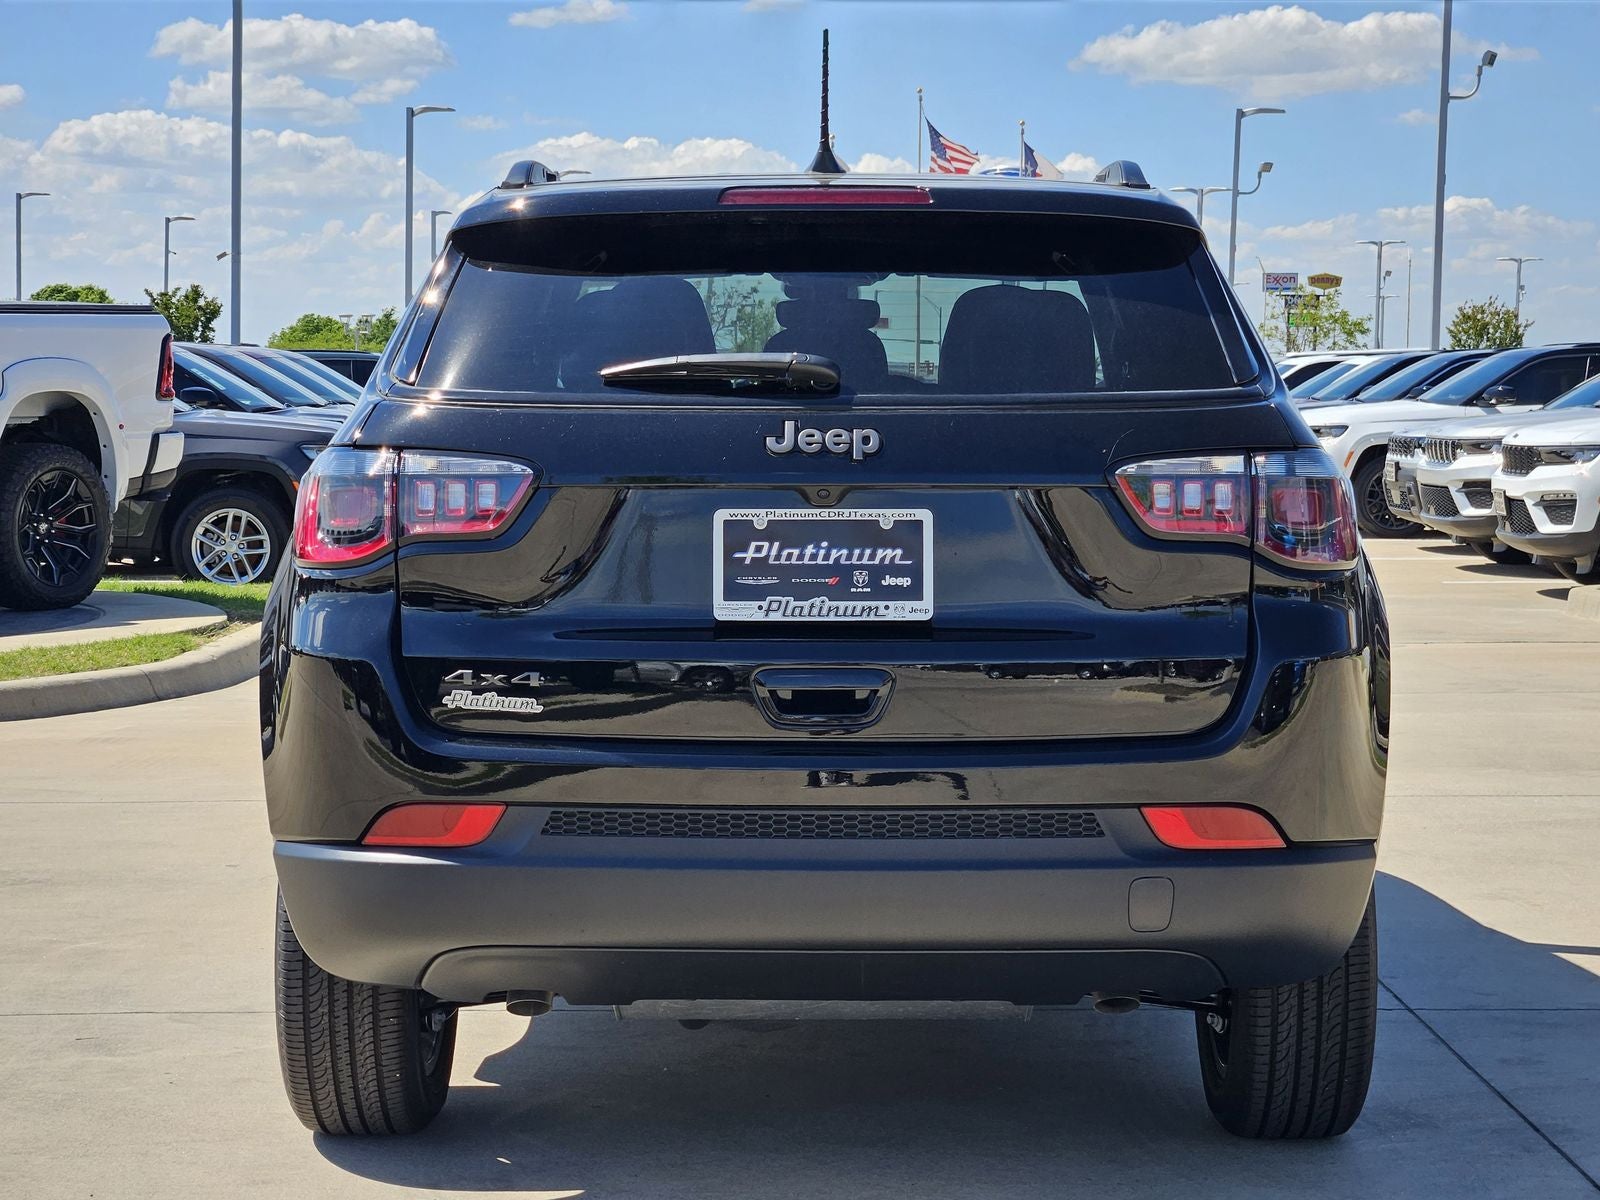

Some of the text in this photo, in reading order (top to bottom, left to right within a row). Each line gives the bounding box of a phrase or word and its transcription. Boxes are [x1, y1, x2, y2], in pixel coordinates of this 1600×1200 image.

[1265, 275, 1296, 286] Exxon
[765, 420, 881, 460] Jeep
[728, 510, 916, 519] www.PlatinumCDRJTexas.com
[732, 541, 912, 565] Platinum
[881, 575, 911, 588] Jeep
[764, 599, 890, 618] Platinum
[908, 606, 930, 614] Jeep
[442, 669, 544, 687] 4x4
[442, 690, 543, 713] Platinum
